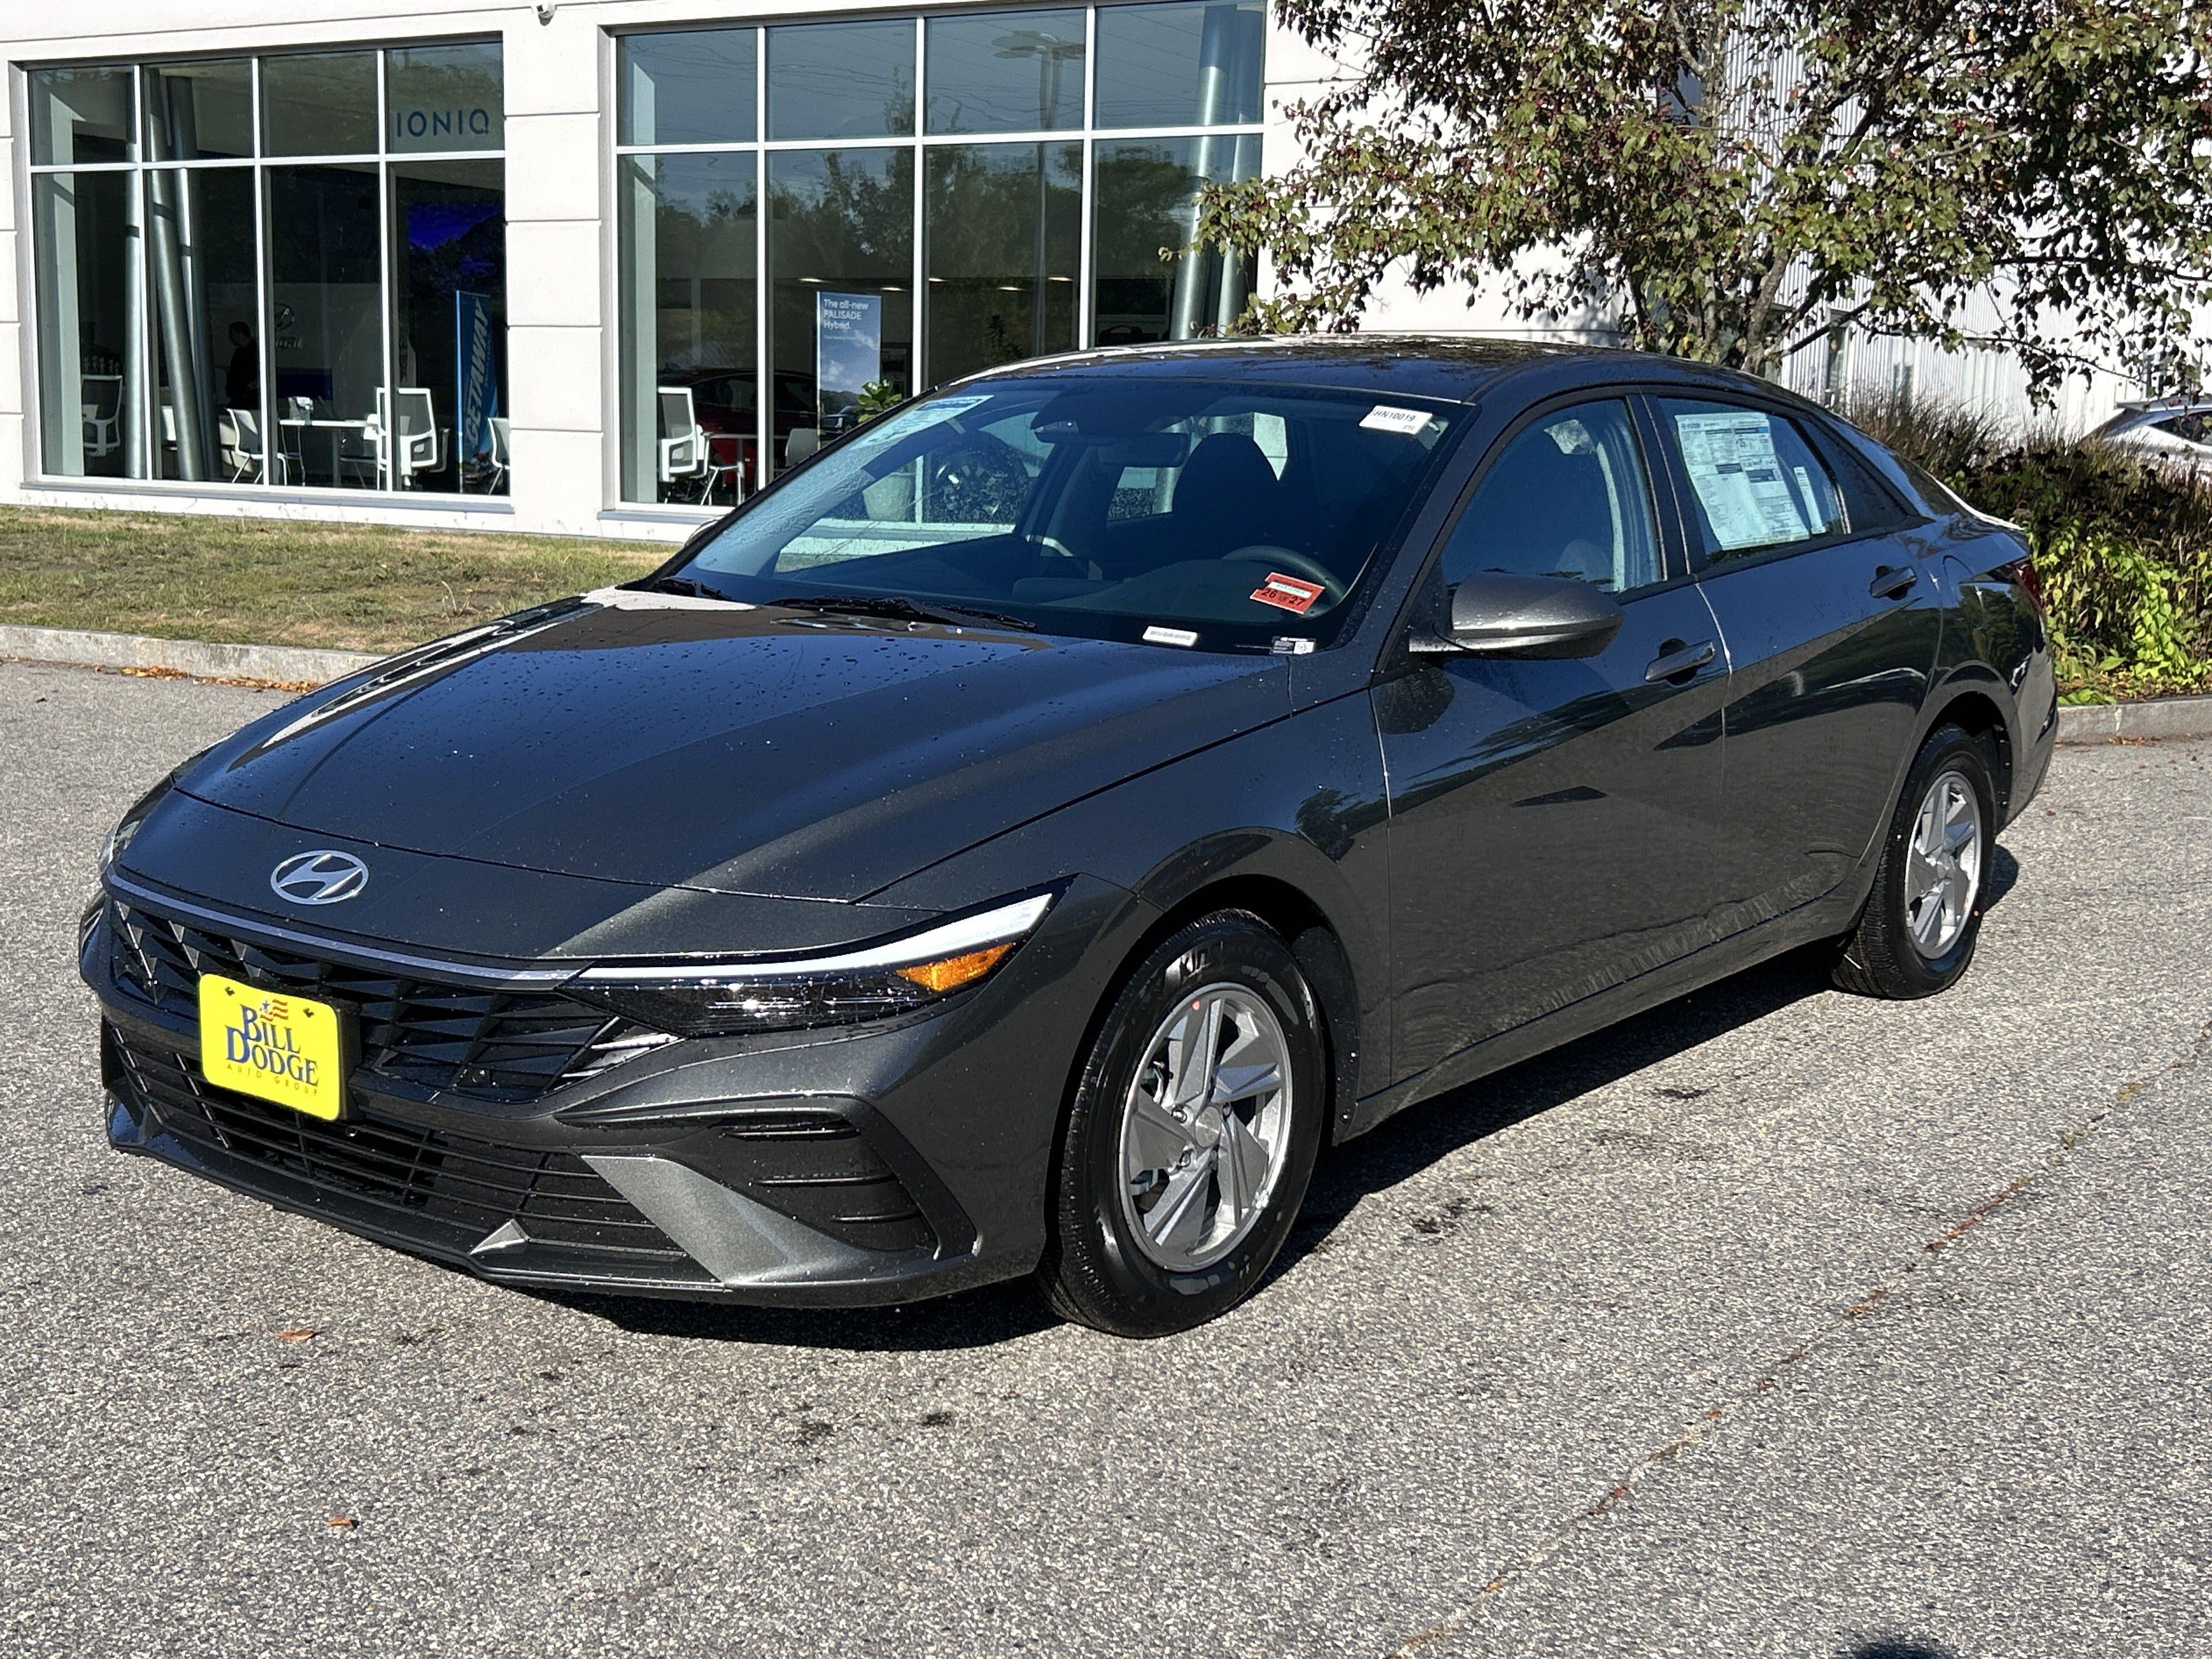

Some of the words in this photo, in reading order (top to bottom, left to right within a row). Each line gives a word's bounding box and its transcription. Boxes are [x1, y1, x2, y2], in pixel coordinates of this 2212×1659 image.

[397, 109, 489, 137] IONIQ
[823, 298, 838, 308] The
[839, 300, 868, 311] all-new
[823, 309, 862, 320] PALISADE
[823, 320, 851, 330] Hybrid.
[466, 297, 488, 448] GETAWAY
[1261, 589, 1278, 599] 26
[1288, 596, 1307, 606] 27
[240, 1003, 301, 1054] BILL
[224, 1025, 319, 1087] DODGE
[227, 1063, 262, 1079] AUTO
[274, 1076, 318, 1097] GROUP
